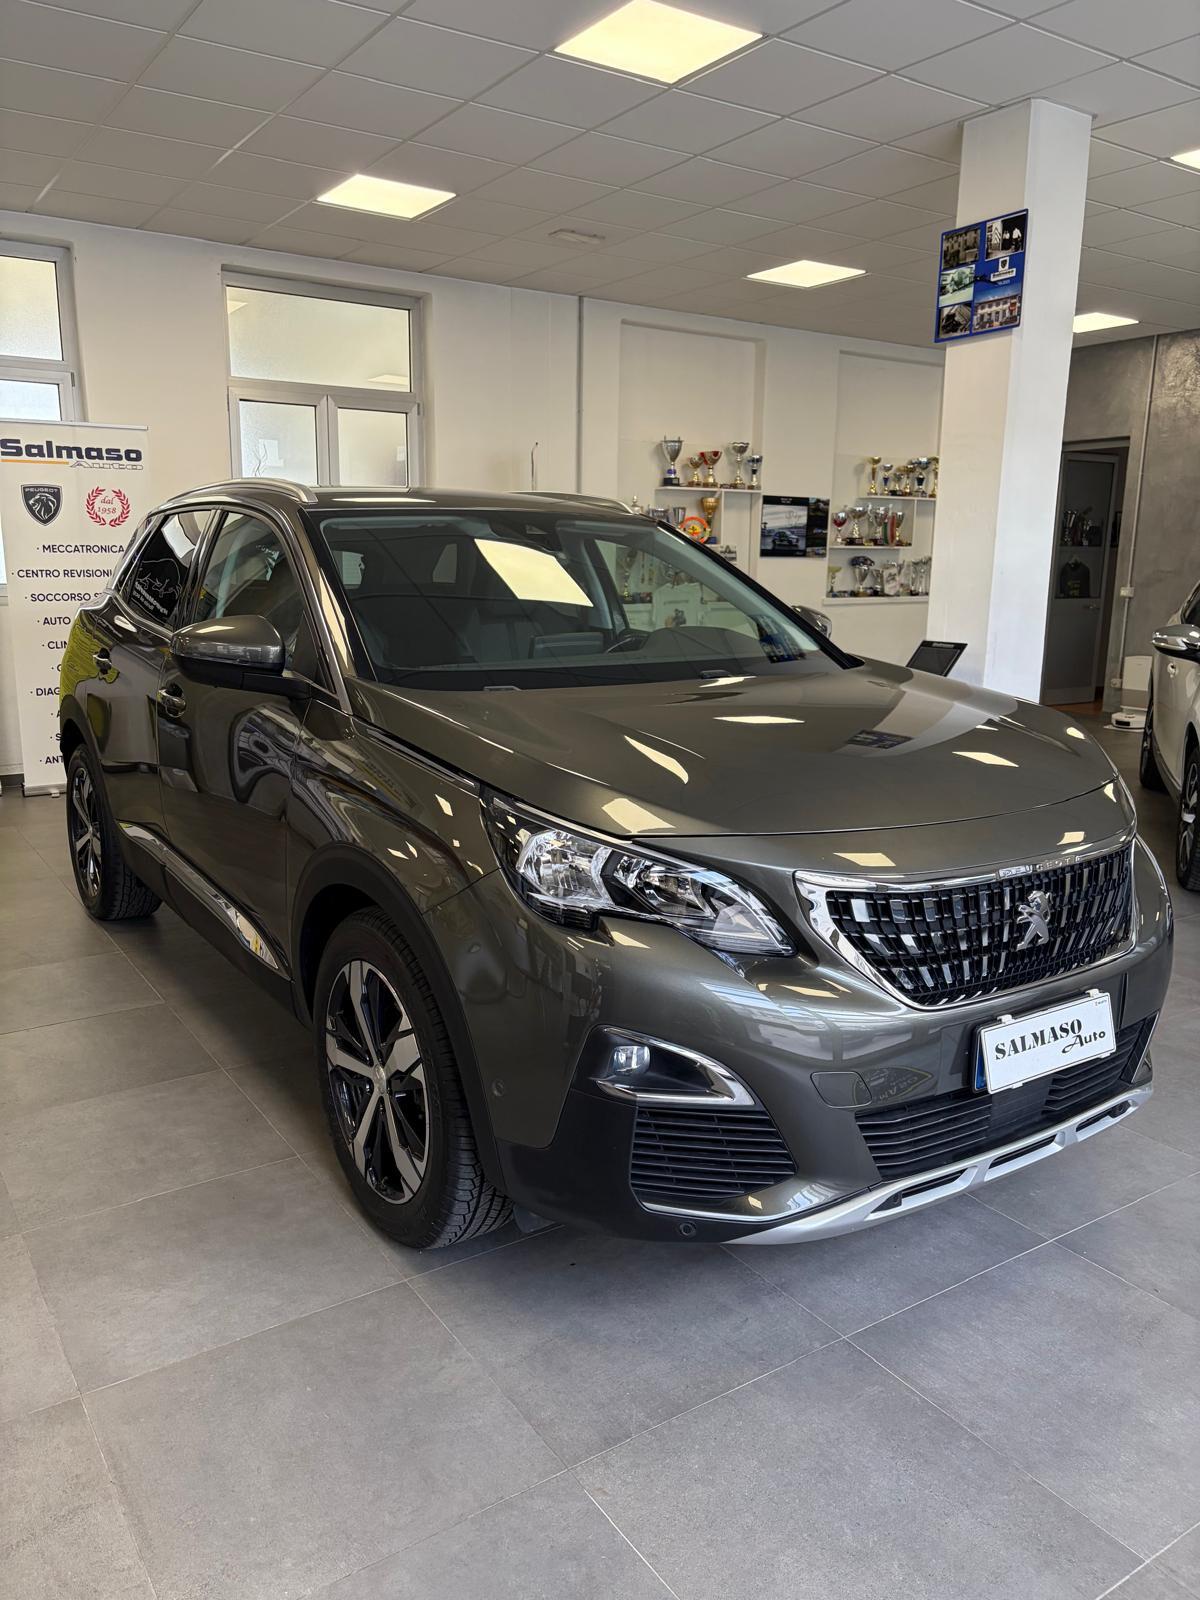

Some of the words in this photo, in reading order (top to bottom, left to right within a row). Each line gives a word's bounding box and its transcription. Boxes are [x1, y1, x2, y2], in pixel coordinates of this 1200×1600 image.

[0, 438, 142, 462] Salmaso
[101, 495, 116, 504] dal
[98, 507, 117, 515] 1958
[42, 544, 125, 554] MECCATRONICA
[17, 569, 61, 578] CENTRO
[30, 592, 91, 602] SOCCORSO
[42, 616, 71, 626] AUTO
[994, 1018, 1083, 1060] SALMASO
[1061, 1030, 1106, 1054] Auto
